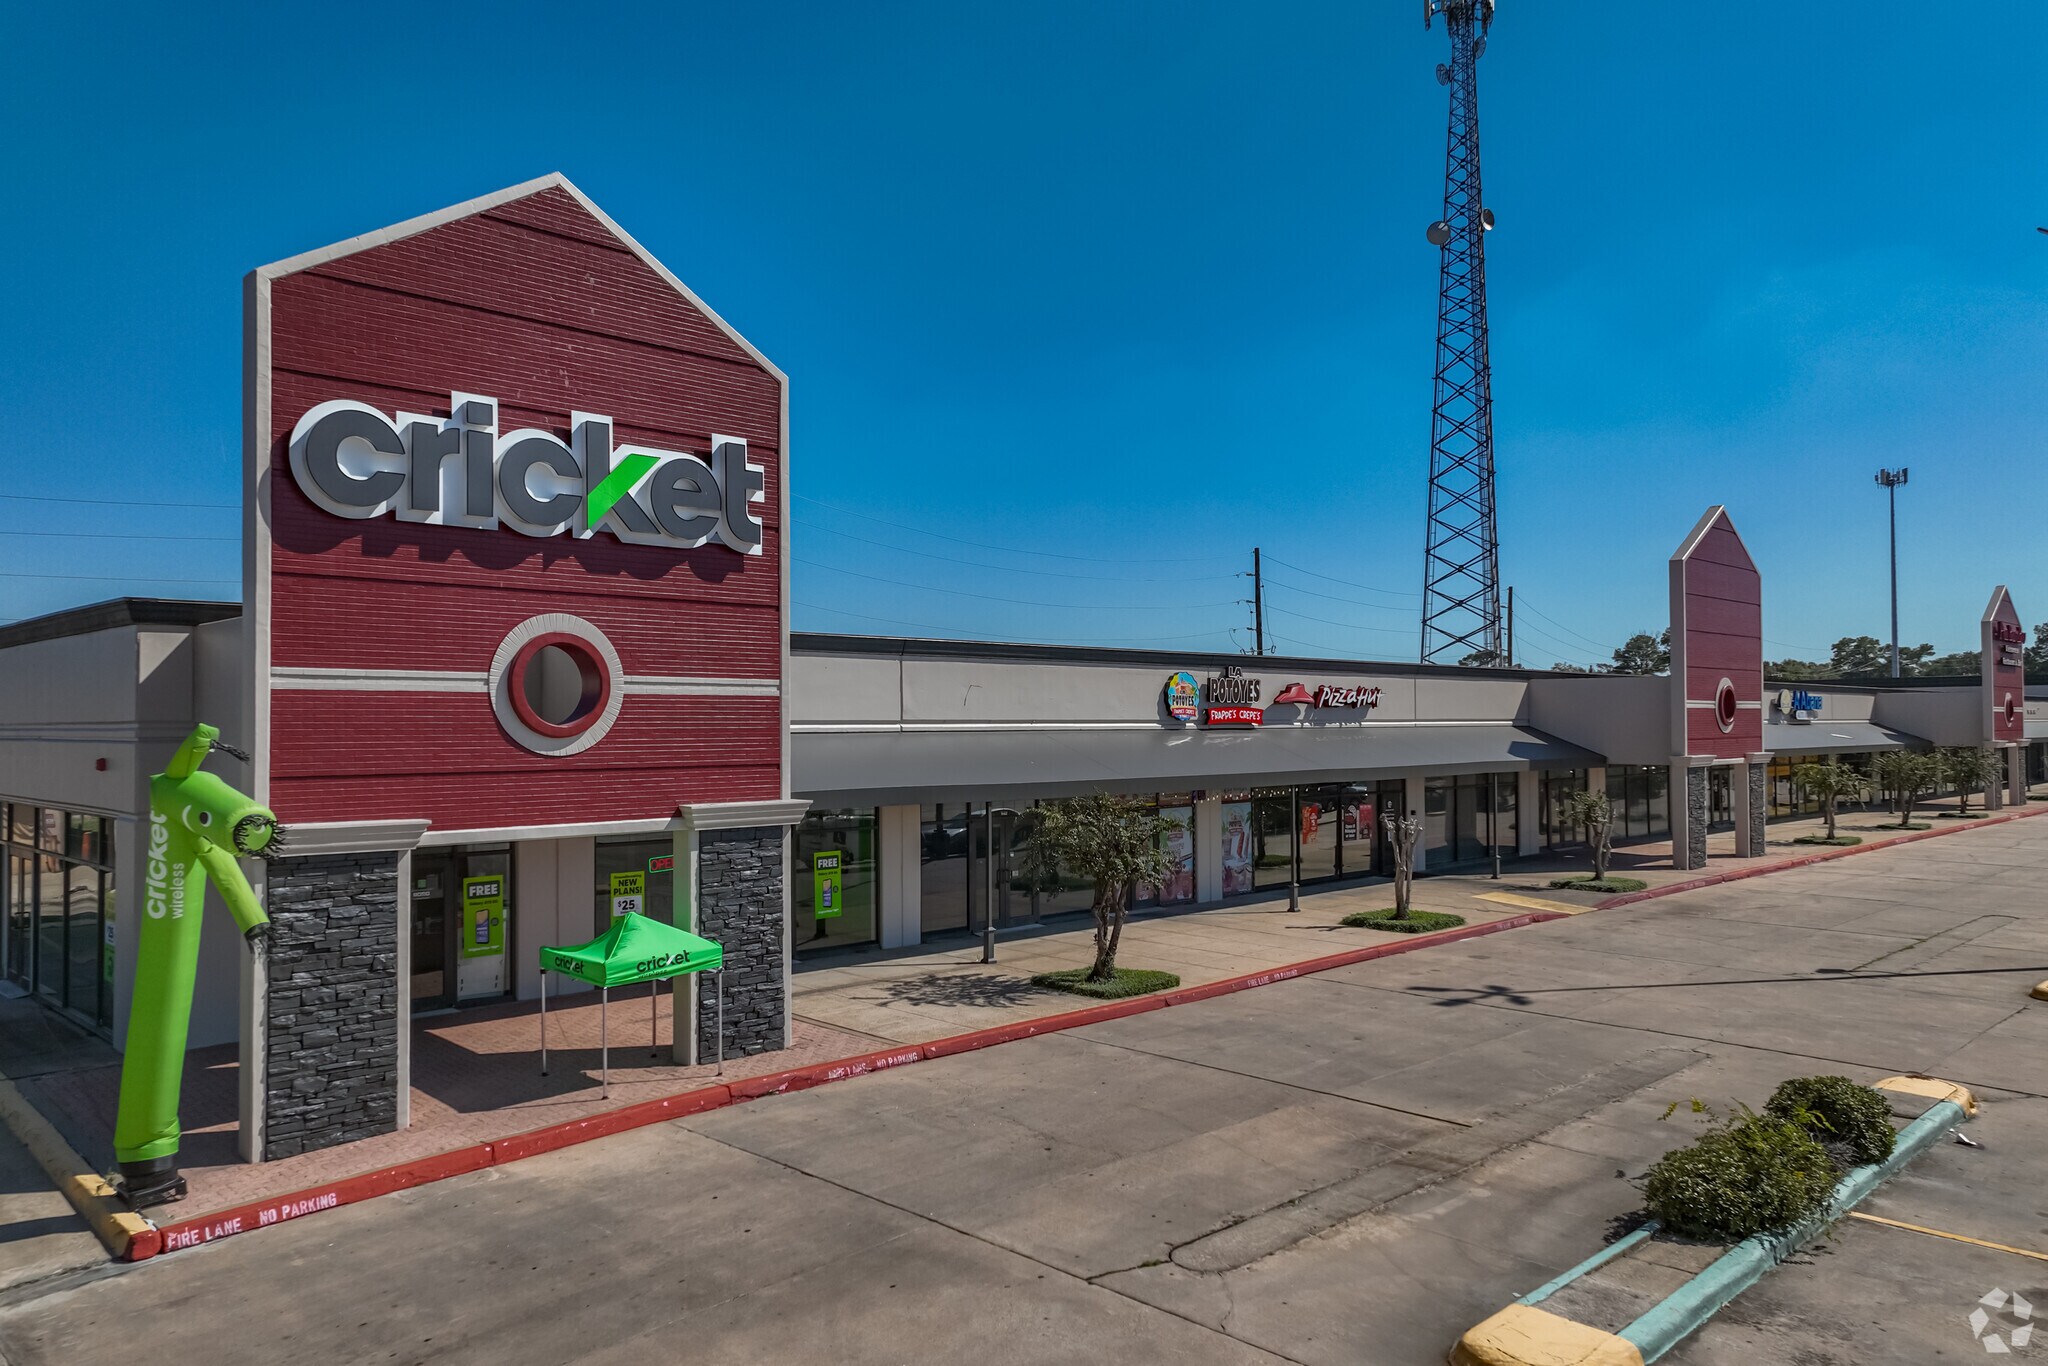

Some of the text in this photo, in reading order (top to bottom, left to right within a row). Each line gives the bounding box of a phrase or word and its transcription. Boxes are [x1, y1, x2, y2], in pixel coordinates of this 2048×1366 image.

[297, 392, 764, 550] cricket
[1227, 665, 1243, 678] LA
[1208, 677, 1261, 704] POTOYES
[651, 857, 675, 871] OPE
[817, 857, 838, 869] FREE
[618, 878, 638, 887] NEW
[169, 862, 185, 919] wireless
[468, 883, 499, 898] FREE
[613, 886, 643, 896] PLANS!
[617, 899, 636, 911] $25
[554, 955, 584, 975] cricket
[636, 949, 691, 974] cricket
[167, 1192, 338, 1250] FIRE LANE NO PARKING
